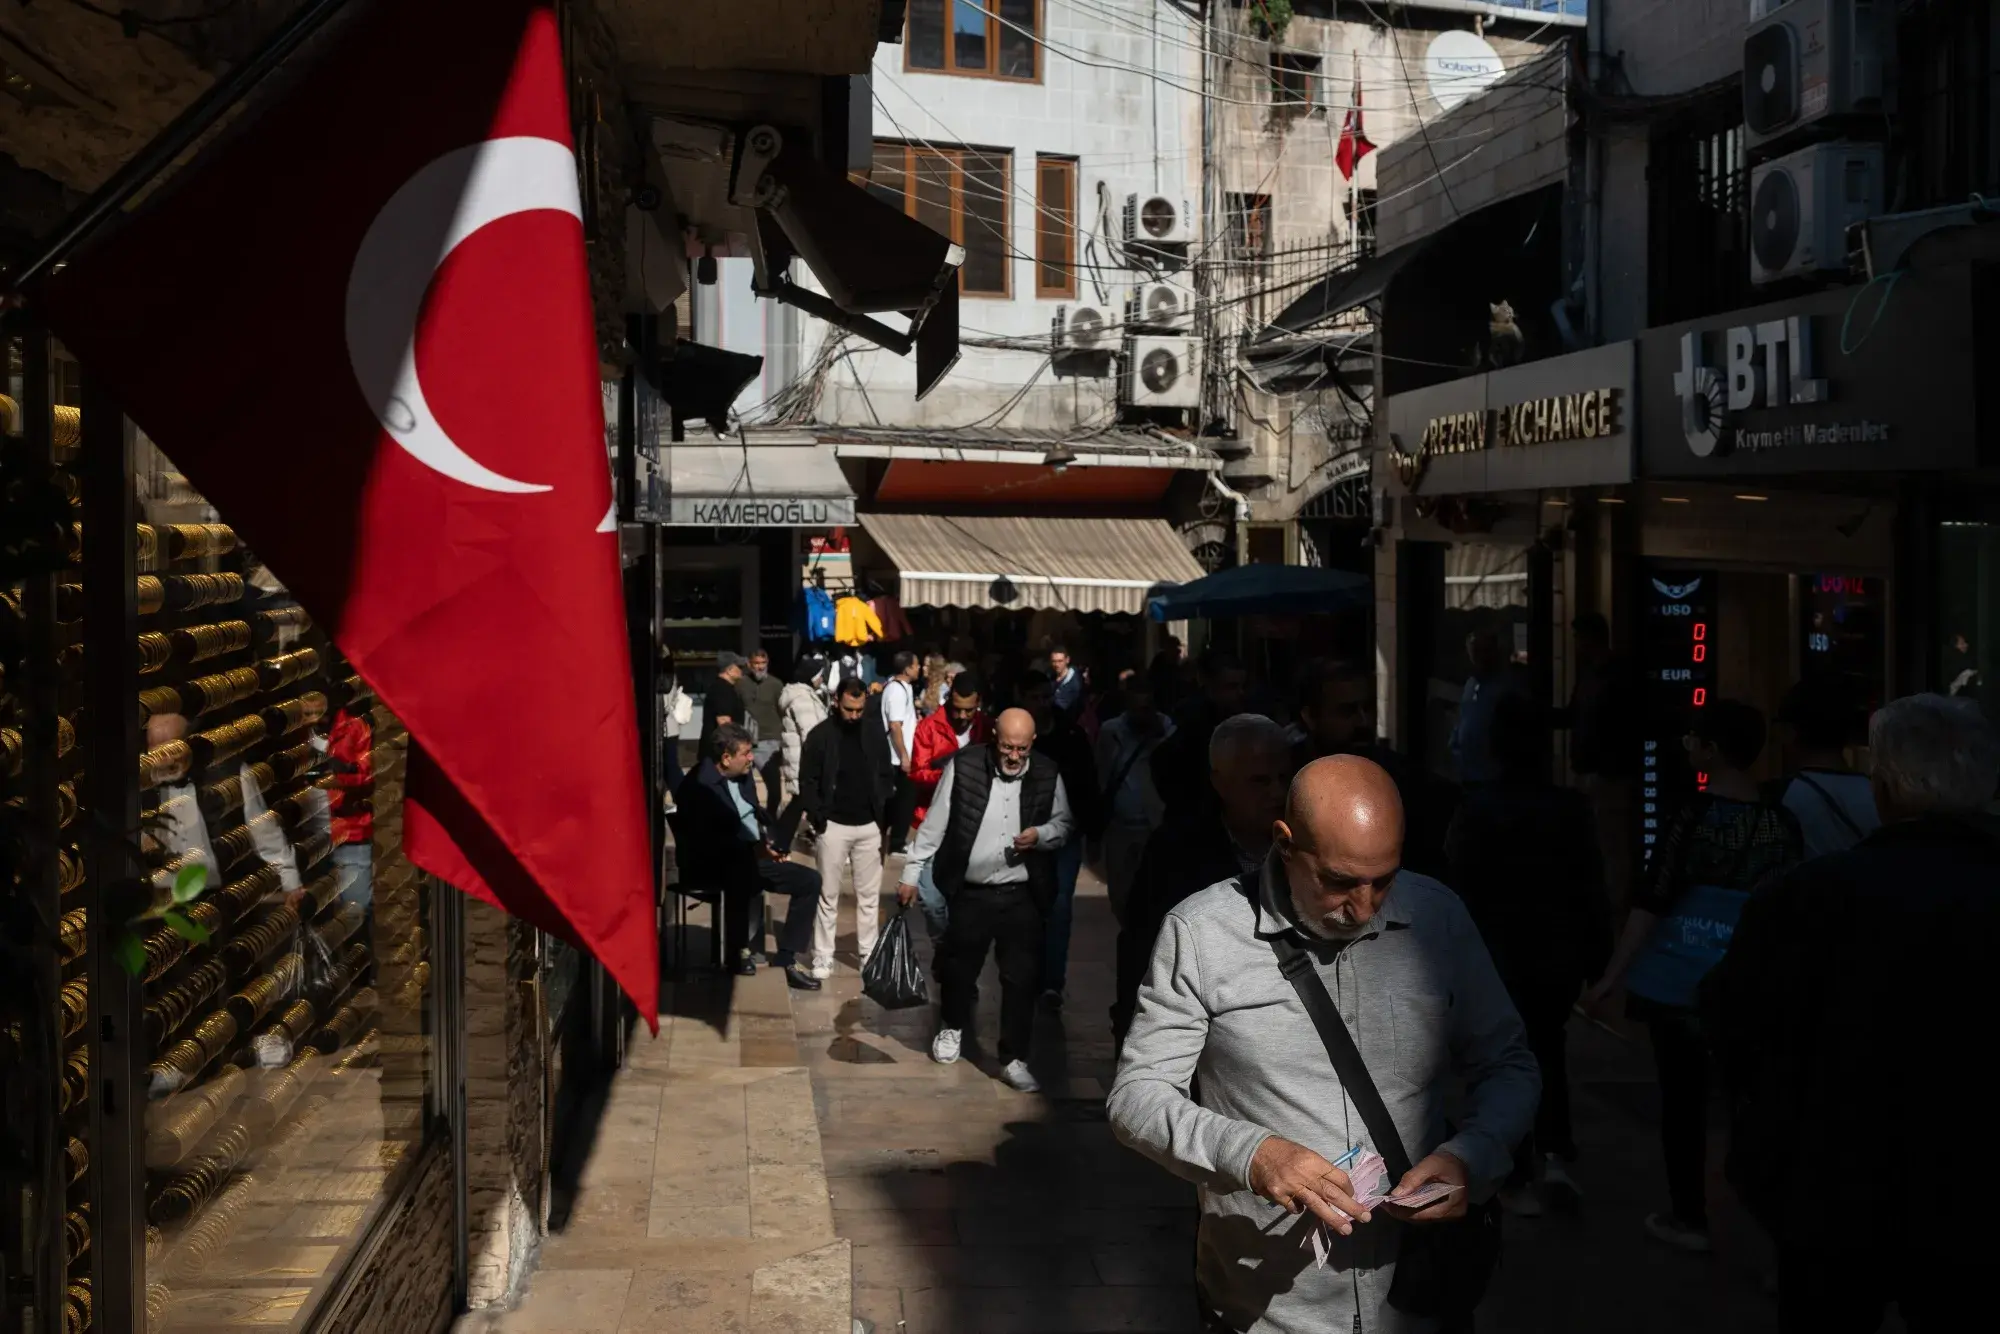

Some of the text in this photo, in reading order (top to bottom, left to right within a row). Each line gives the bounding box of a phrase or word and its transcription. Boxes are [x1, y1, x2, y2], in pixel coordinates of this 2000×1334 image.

[1726, 315, 1829, 412] BTL
[1429, 409, 1488, 456] REZERV
[1803, 418, 1889, 445] Madenler
[693, 498, 828, 524] KAMEROĞLU
[1661, 604, 1692, 616] USD
[1693, 623, 1706, 641] 0
[1807, 632, 1829, 652] USD
[1692, 644, 1706, 662] 0
[1661, 668, 1692, 681] EUR
[1693, 687, 1706, 706] 0
